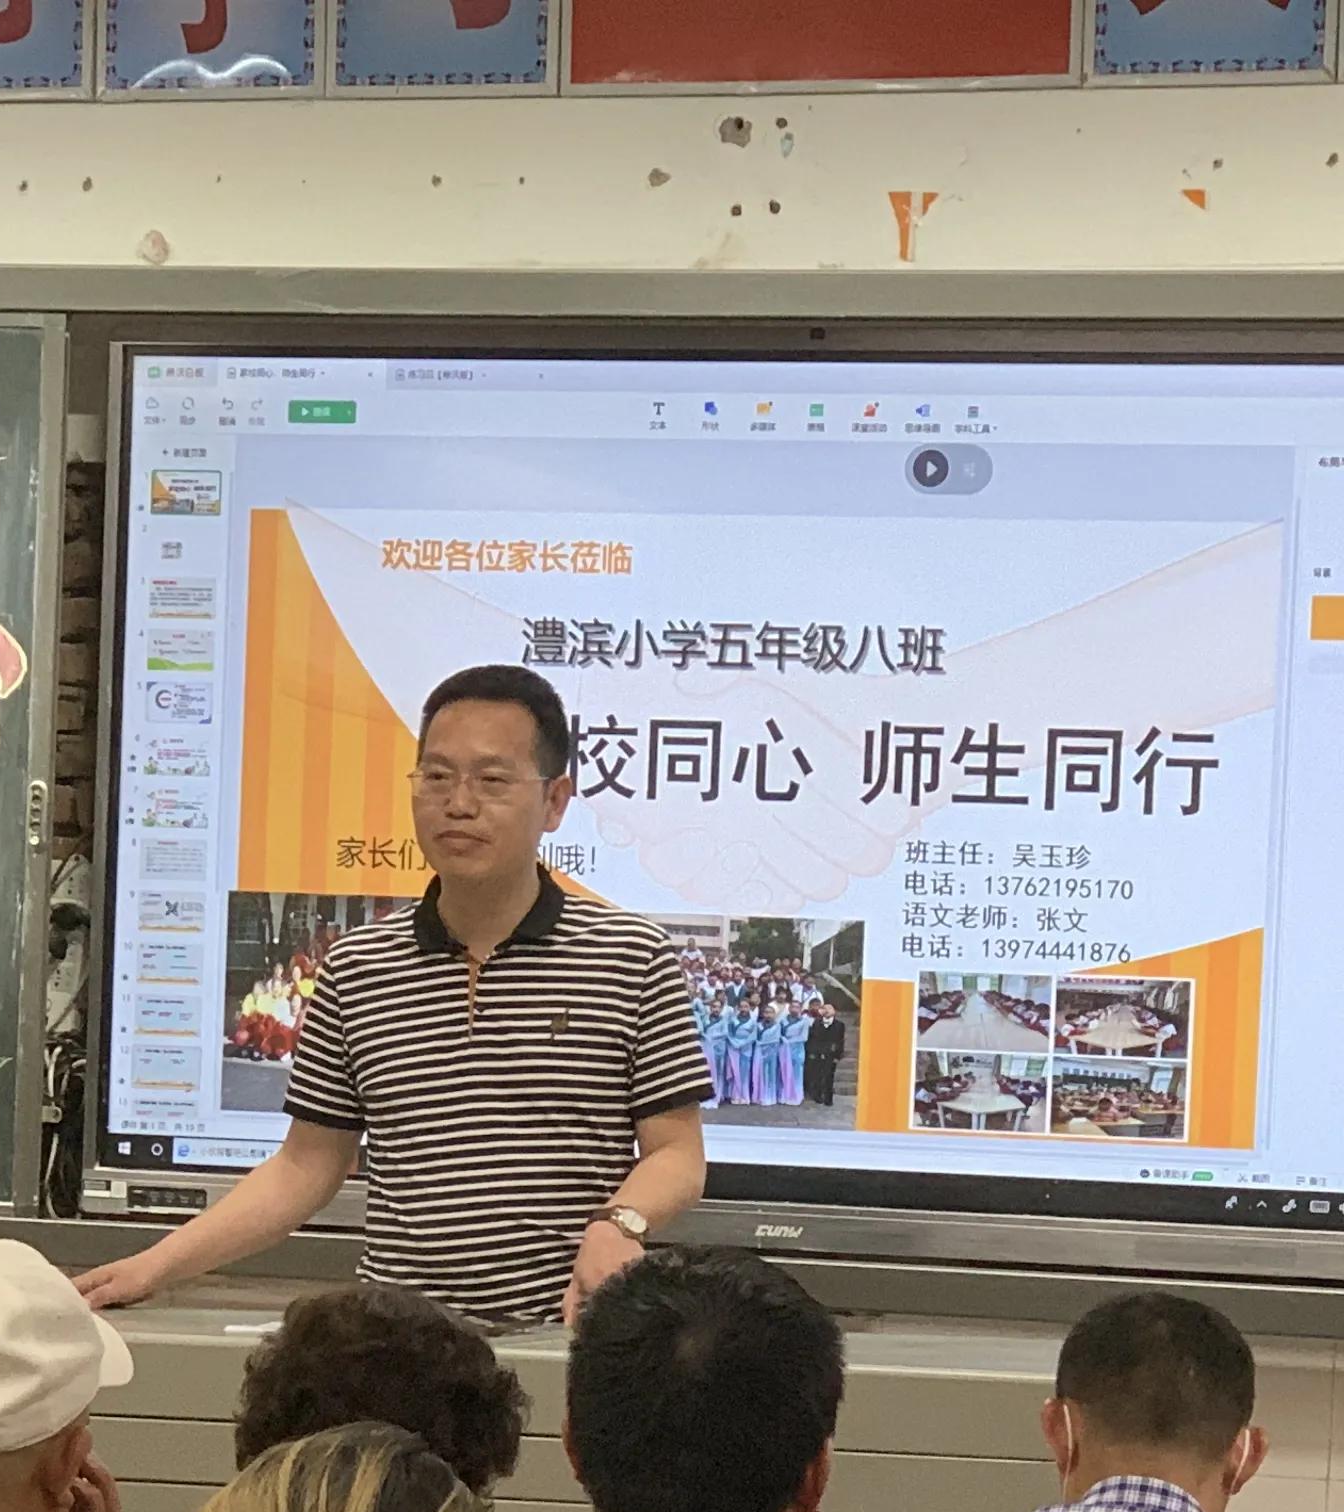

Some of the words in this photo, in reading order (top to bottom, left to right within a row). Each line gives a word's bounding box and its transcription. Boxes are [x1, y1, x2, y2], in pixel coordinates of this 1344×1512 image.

[382, 538, 633, 575] 欢迎各位家长莅临
[522, 616, 948, 677] 澧滨小学五年级八班
[860, 718, 1221, 818] 师生同行
